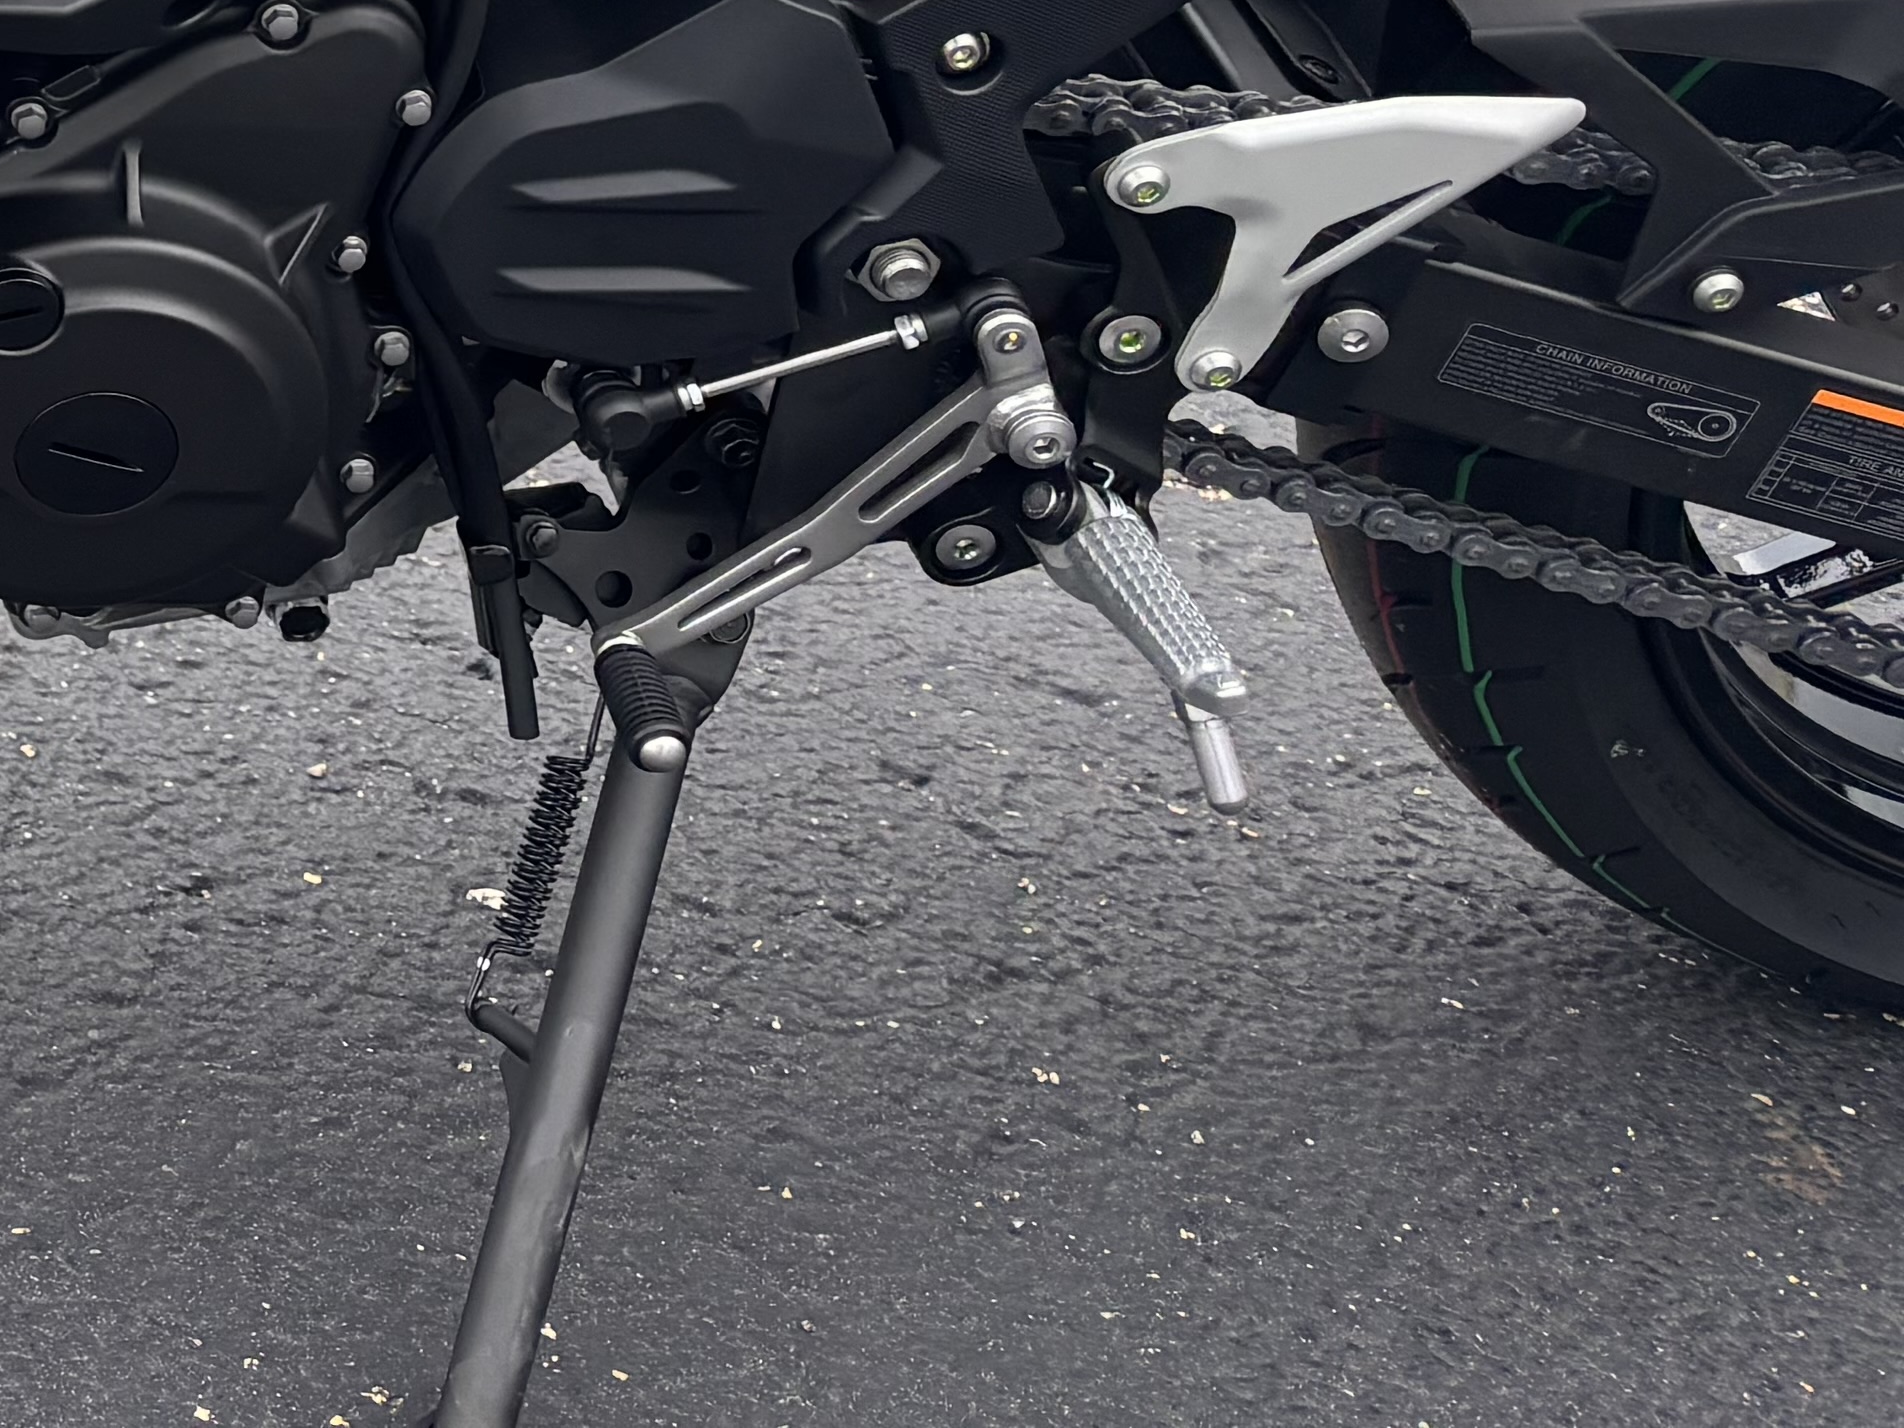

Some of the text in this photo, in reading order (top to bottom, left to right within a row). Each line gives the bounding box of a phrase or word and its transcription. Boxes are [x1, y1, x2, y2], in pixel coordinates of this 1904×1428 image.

[1535, 344, 1693, 395] CHAIN INFORMATION
[1848, 455, 1904, 479] TIRE AN
